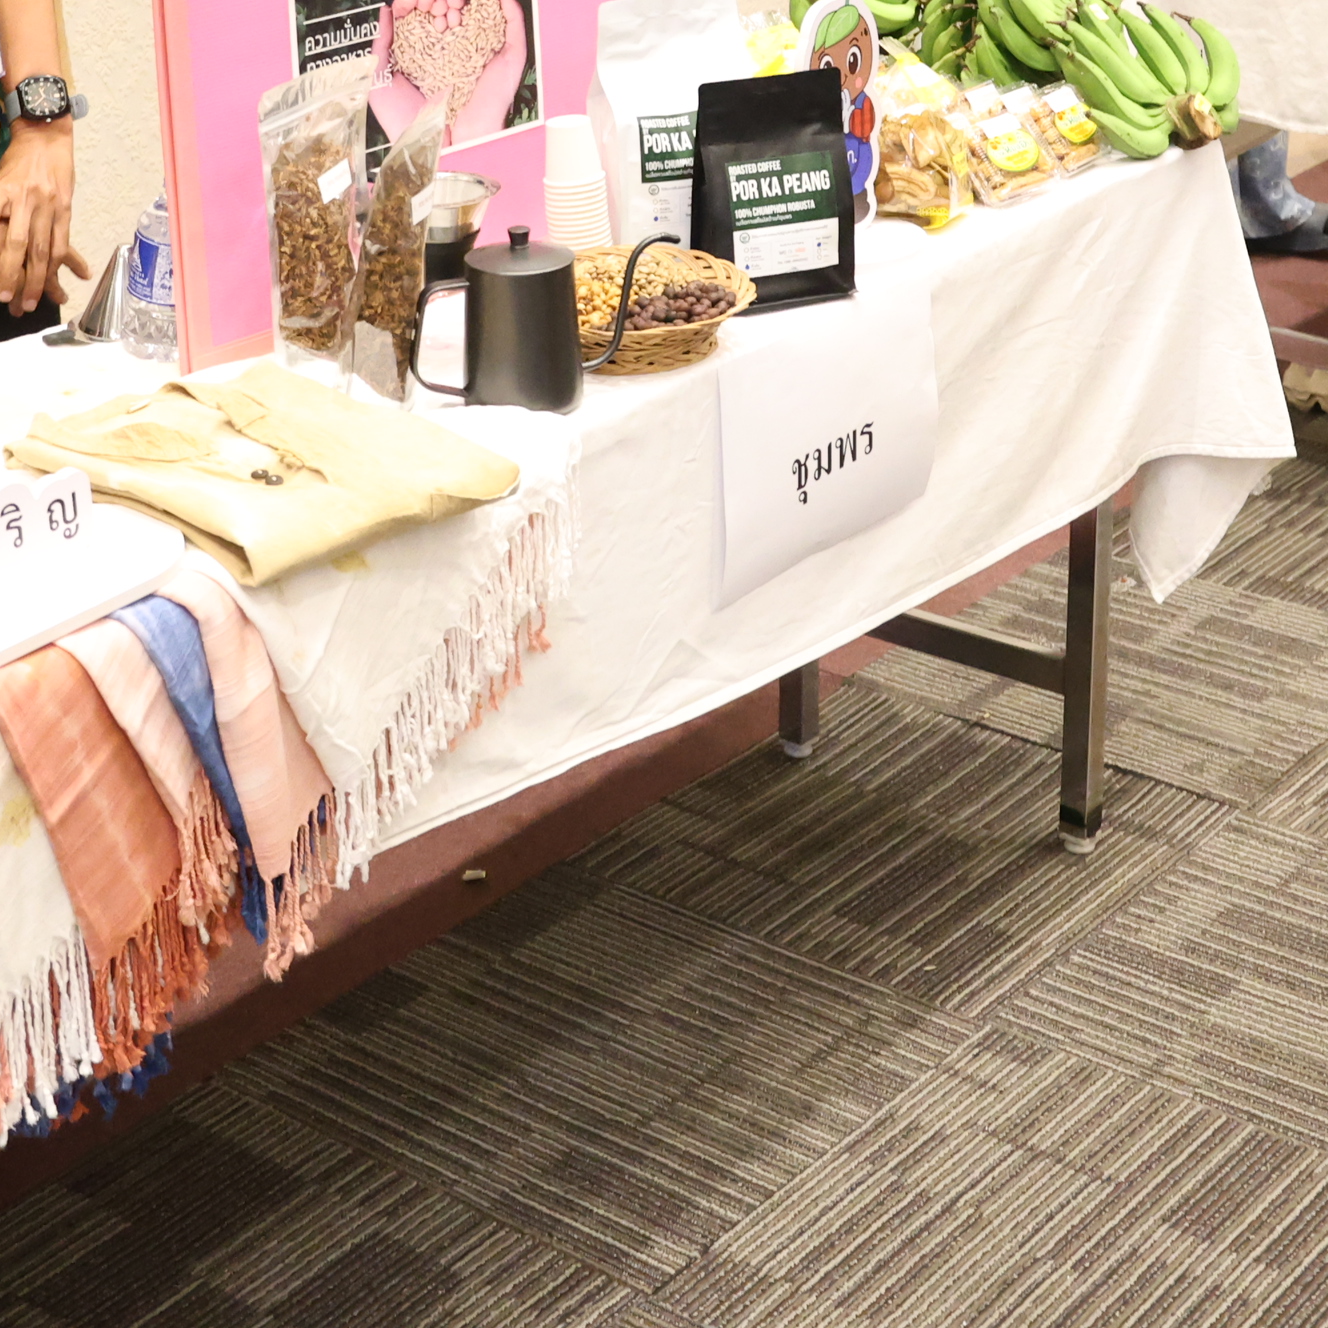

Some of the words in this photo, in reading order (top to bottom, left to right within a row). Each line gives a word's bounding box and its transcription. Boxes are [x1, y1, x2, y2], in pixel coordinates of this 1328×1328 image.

[304, 17, 380, 53] ความมั่นคง
[643, 132, 672, 155] POR
[670, 130, 693, 152] KA
[645, 161, 664, 172] 100%
[664, 157, 694, 171] CHUMPHO
[728, 163, 758, 176] ROASTED
[757, 159, 782, 173] COFFEE
[731, 179, 760, 202] POR
[760, 175, 782, 198] KA
[783, 169, 831, 195] PEANG
[734, 208, 752, 219] 100%
[752, 202, 788, 218] CHUMPHON
[787, 198, 816, 213] ROBUSTA
[792, 421, 874, 505] ชุมพร
